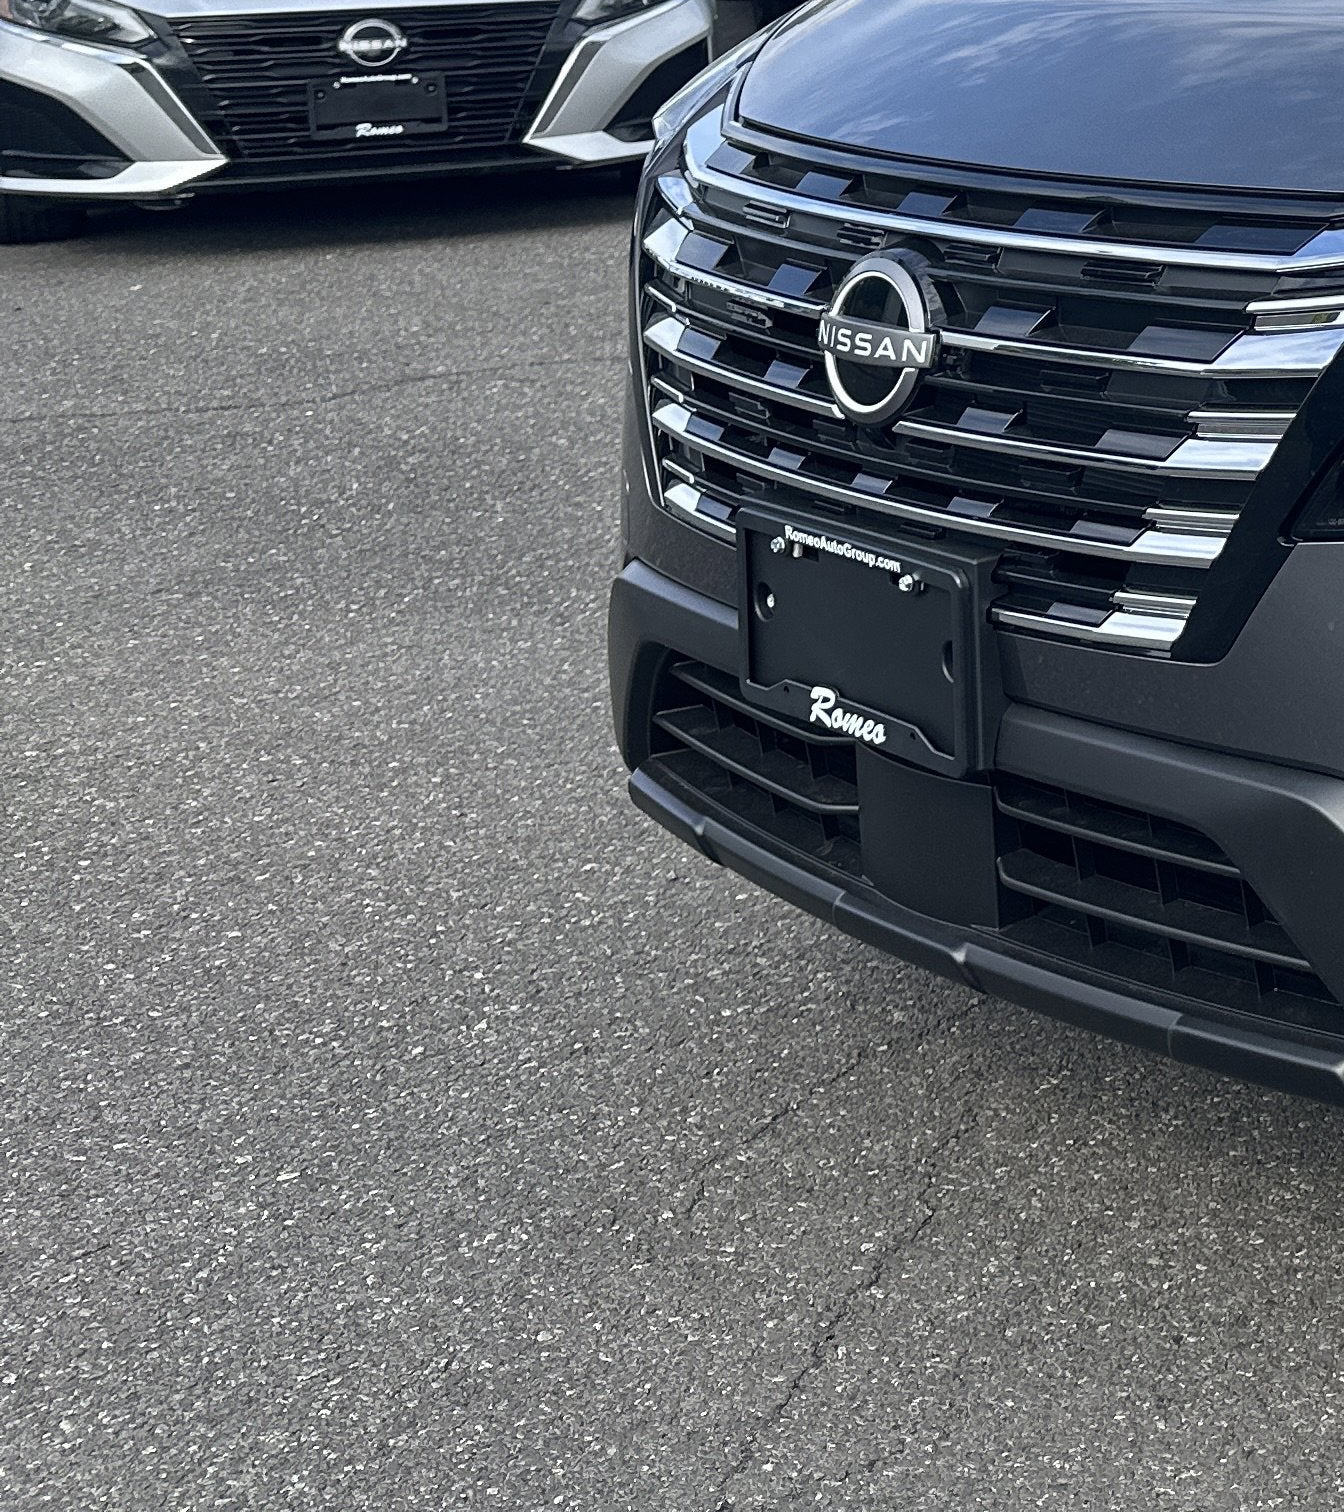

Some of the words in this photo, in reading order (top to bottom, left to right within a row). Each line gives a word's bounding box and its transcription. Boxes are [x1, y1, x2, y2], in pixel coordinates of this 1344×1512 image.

[339, 38, 408, 52] NISSAN
[818, 319, 928, 364] NISSAN
[784, 524, 902, 574] RomeoAutoGroup.com
[809, 685, 887, 745] Romeo
